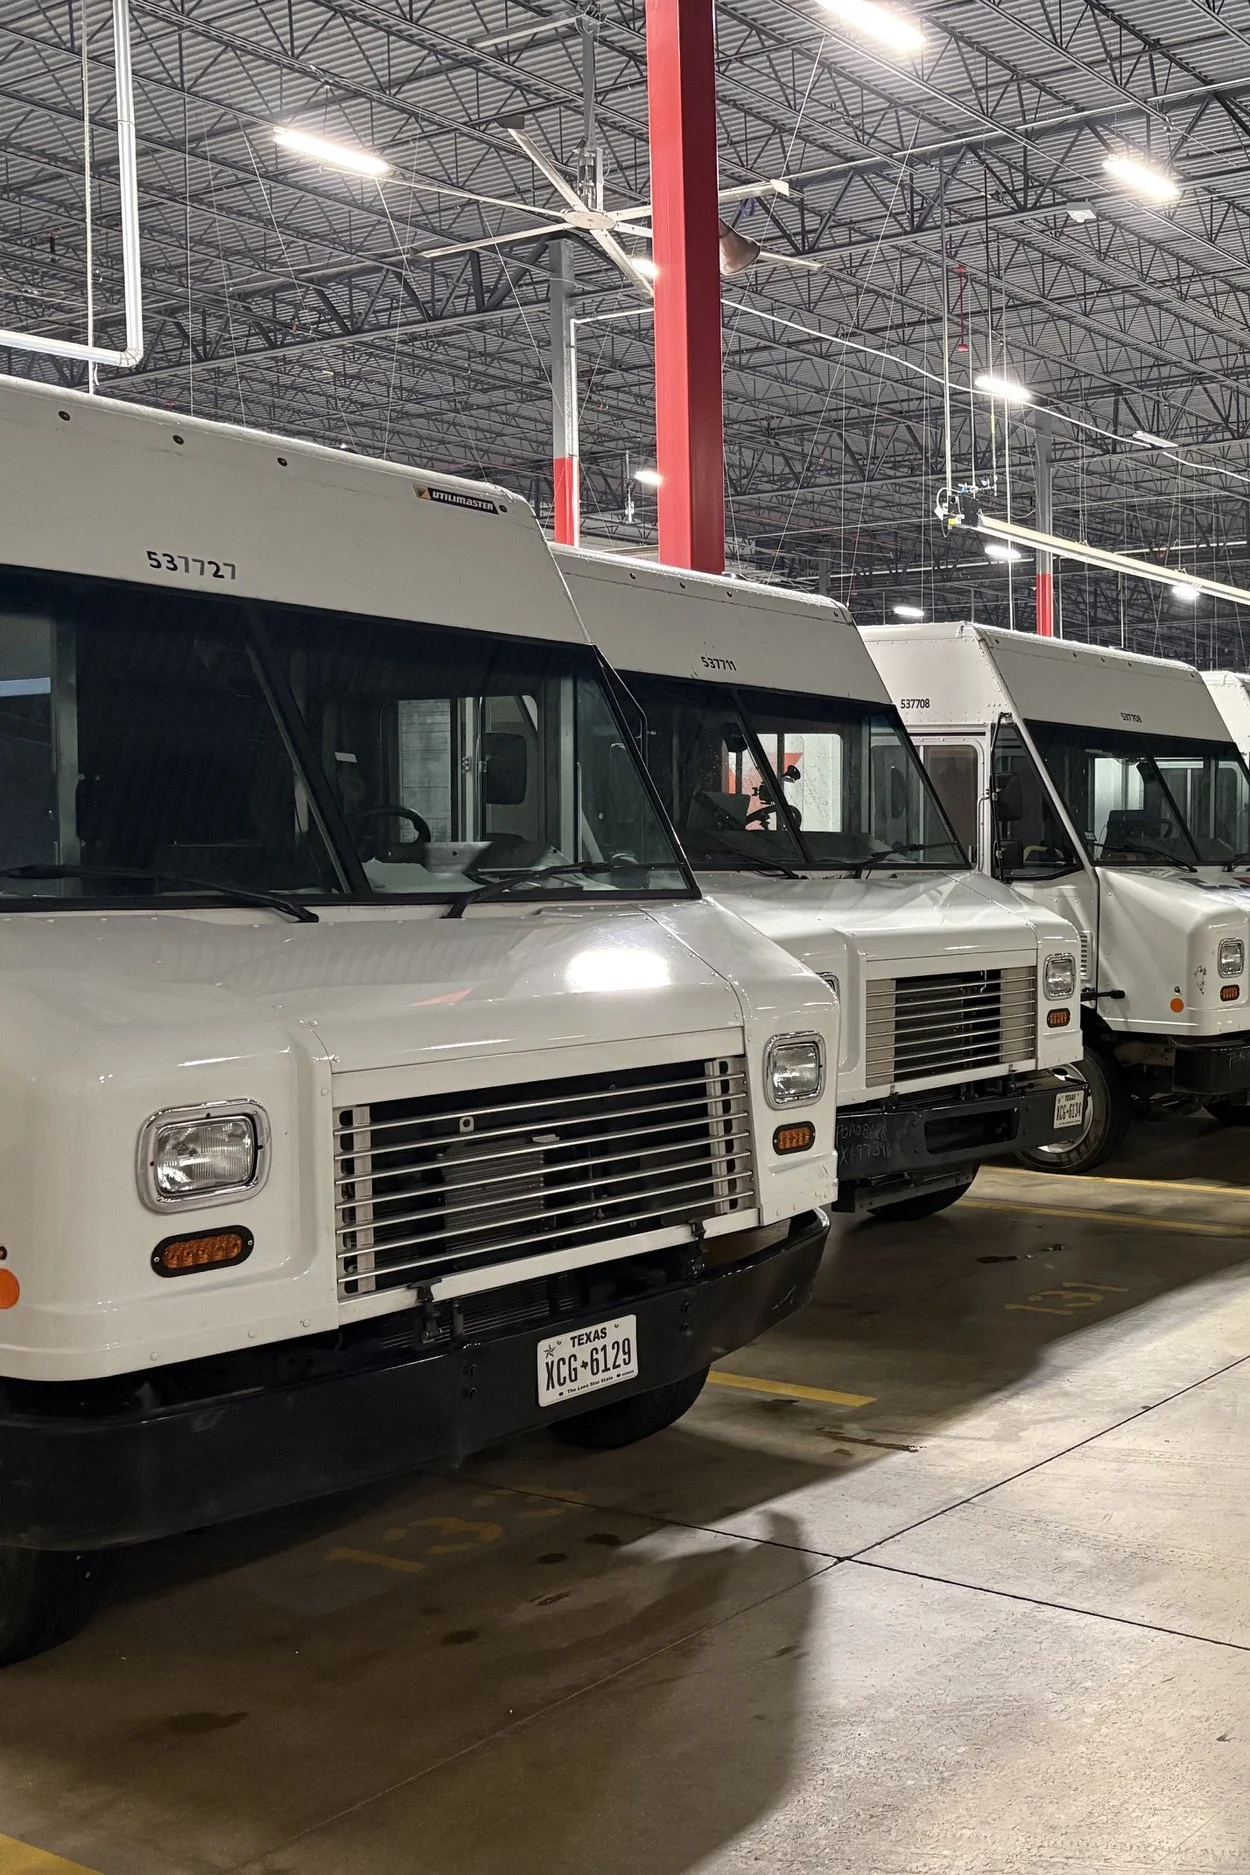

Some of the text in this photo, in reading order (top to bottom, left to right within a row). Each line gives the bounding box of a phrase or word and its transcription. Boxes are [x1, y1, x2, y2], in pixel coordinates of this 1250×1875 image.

[432, 491, 494, 510] UTILIMASTER
[146, 550, 235, 580] 537727
[700, 656, 737, 671] 537711
[900, 698, 930, 709] 537708
[1004, 1281, 1129, 1315] 131
[570, 1327, 607, 1348] TEXAS
